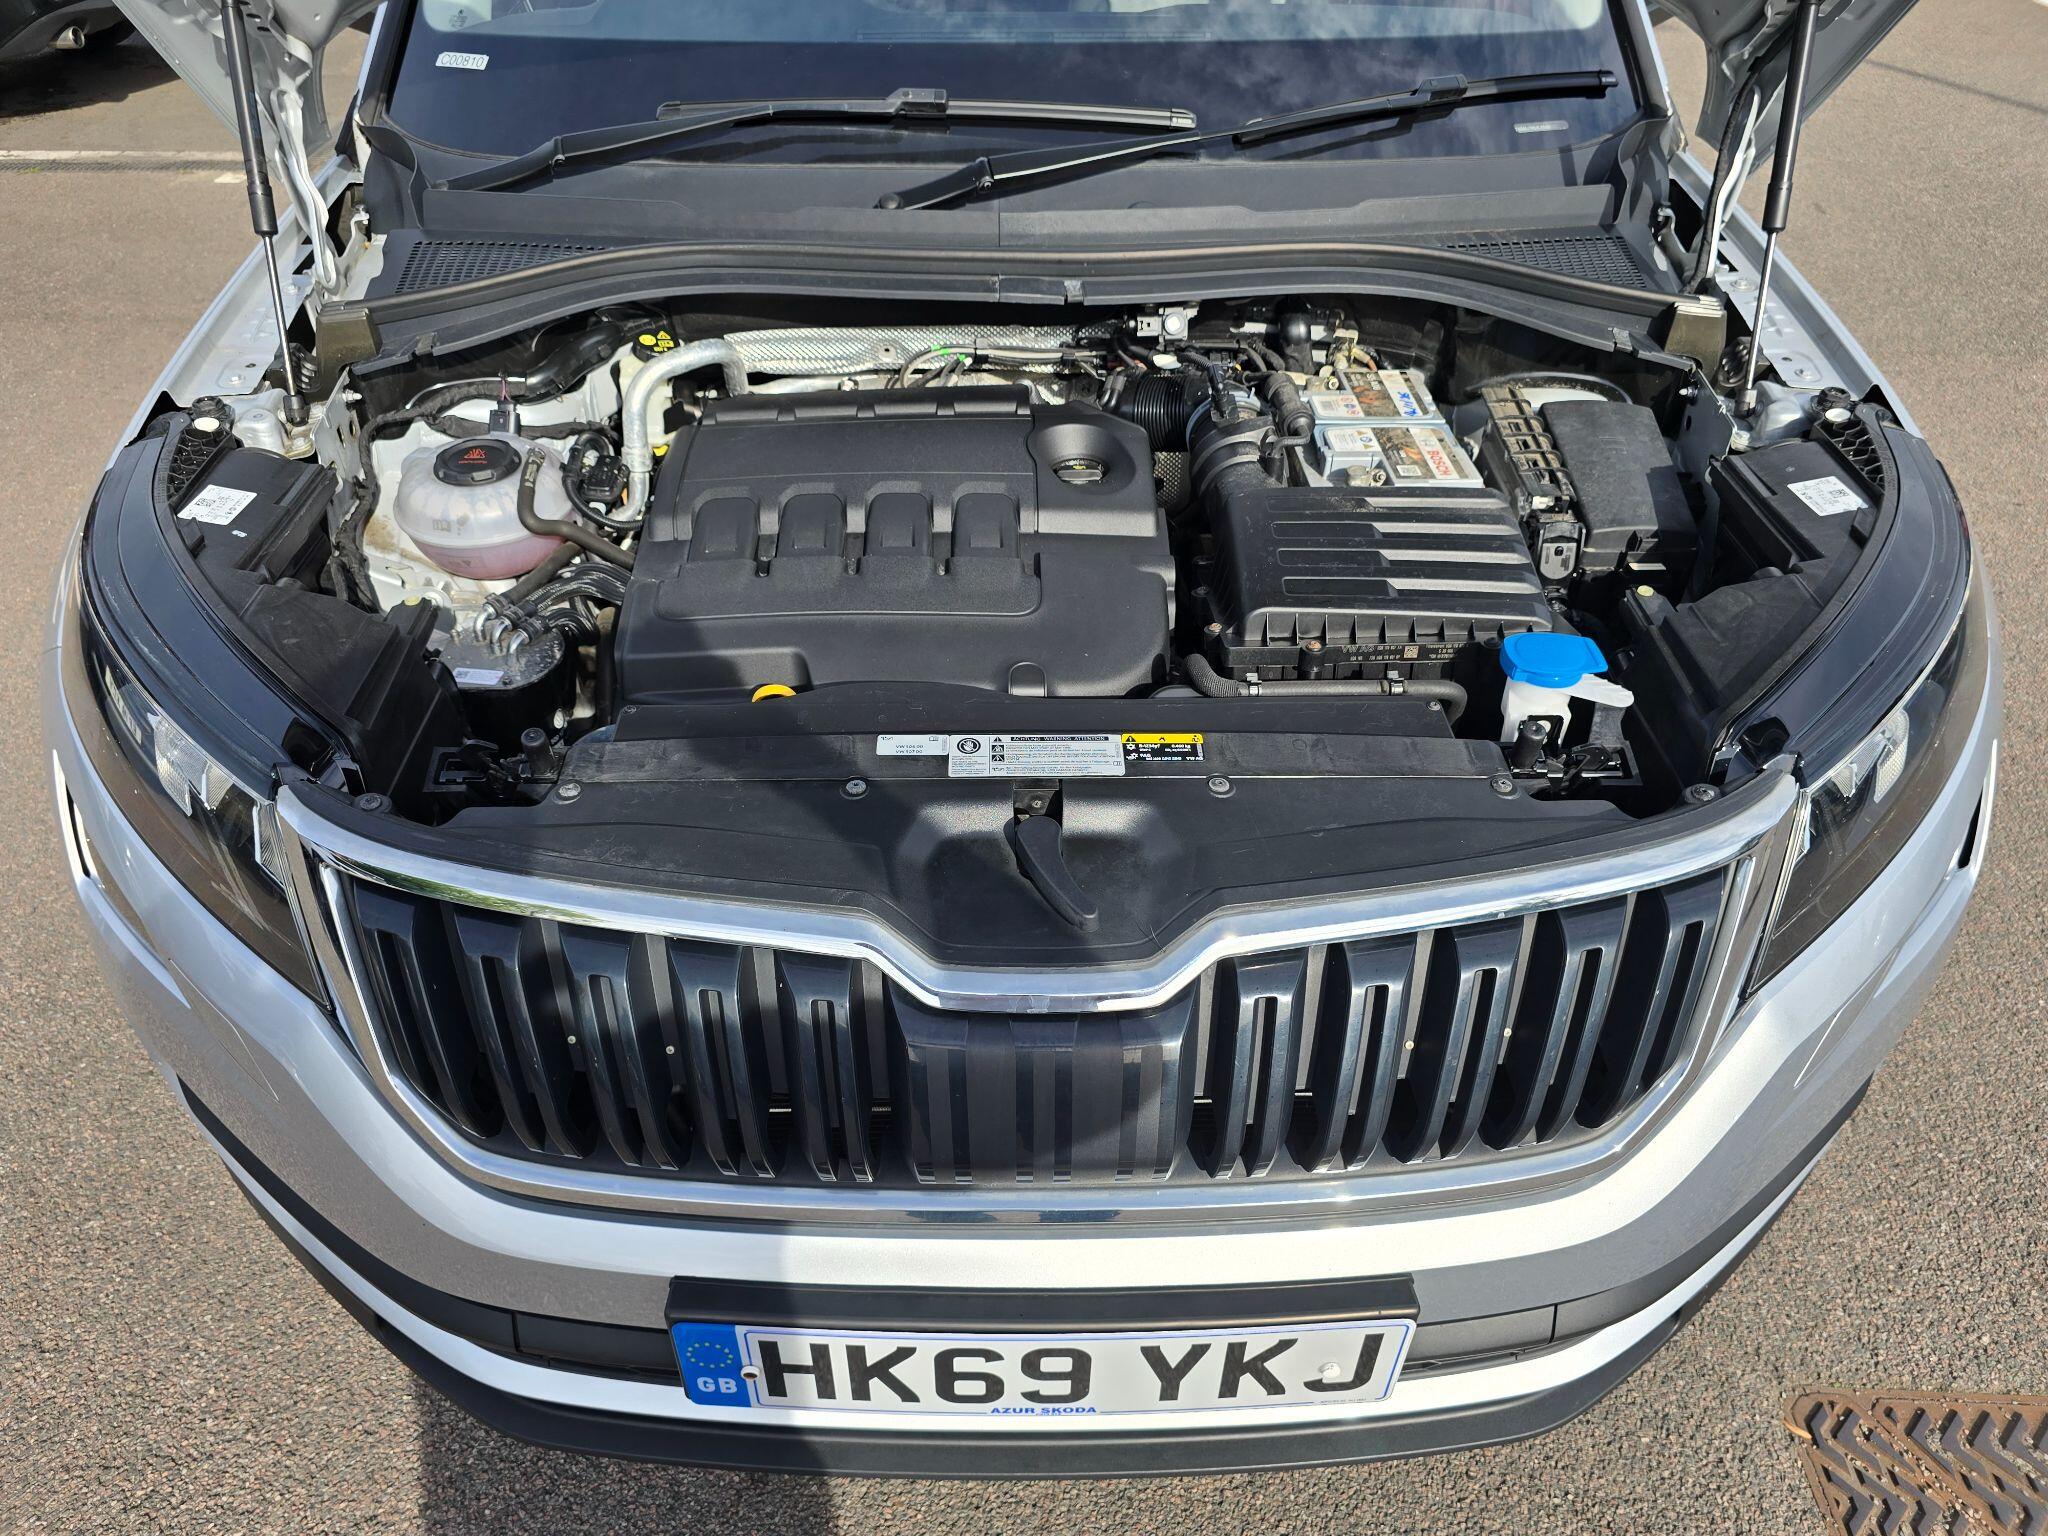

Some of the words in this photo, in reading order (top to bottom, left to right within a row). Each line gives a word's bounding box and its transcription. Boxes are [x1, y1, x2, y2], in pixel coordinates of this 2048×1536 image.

[441, 54, 485, 68] C00810
[1427, 450, 1453, 476] BOSCH
[757, 1340, 1092, 1404] HK69
[1140, 1333, 1385, 1401] YKJ
[696, 1376, 738, 1394] GB
[1041, 1406, 1097, 1414] SKODA
